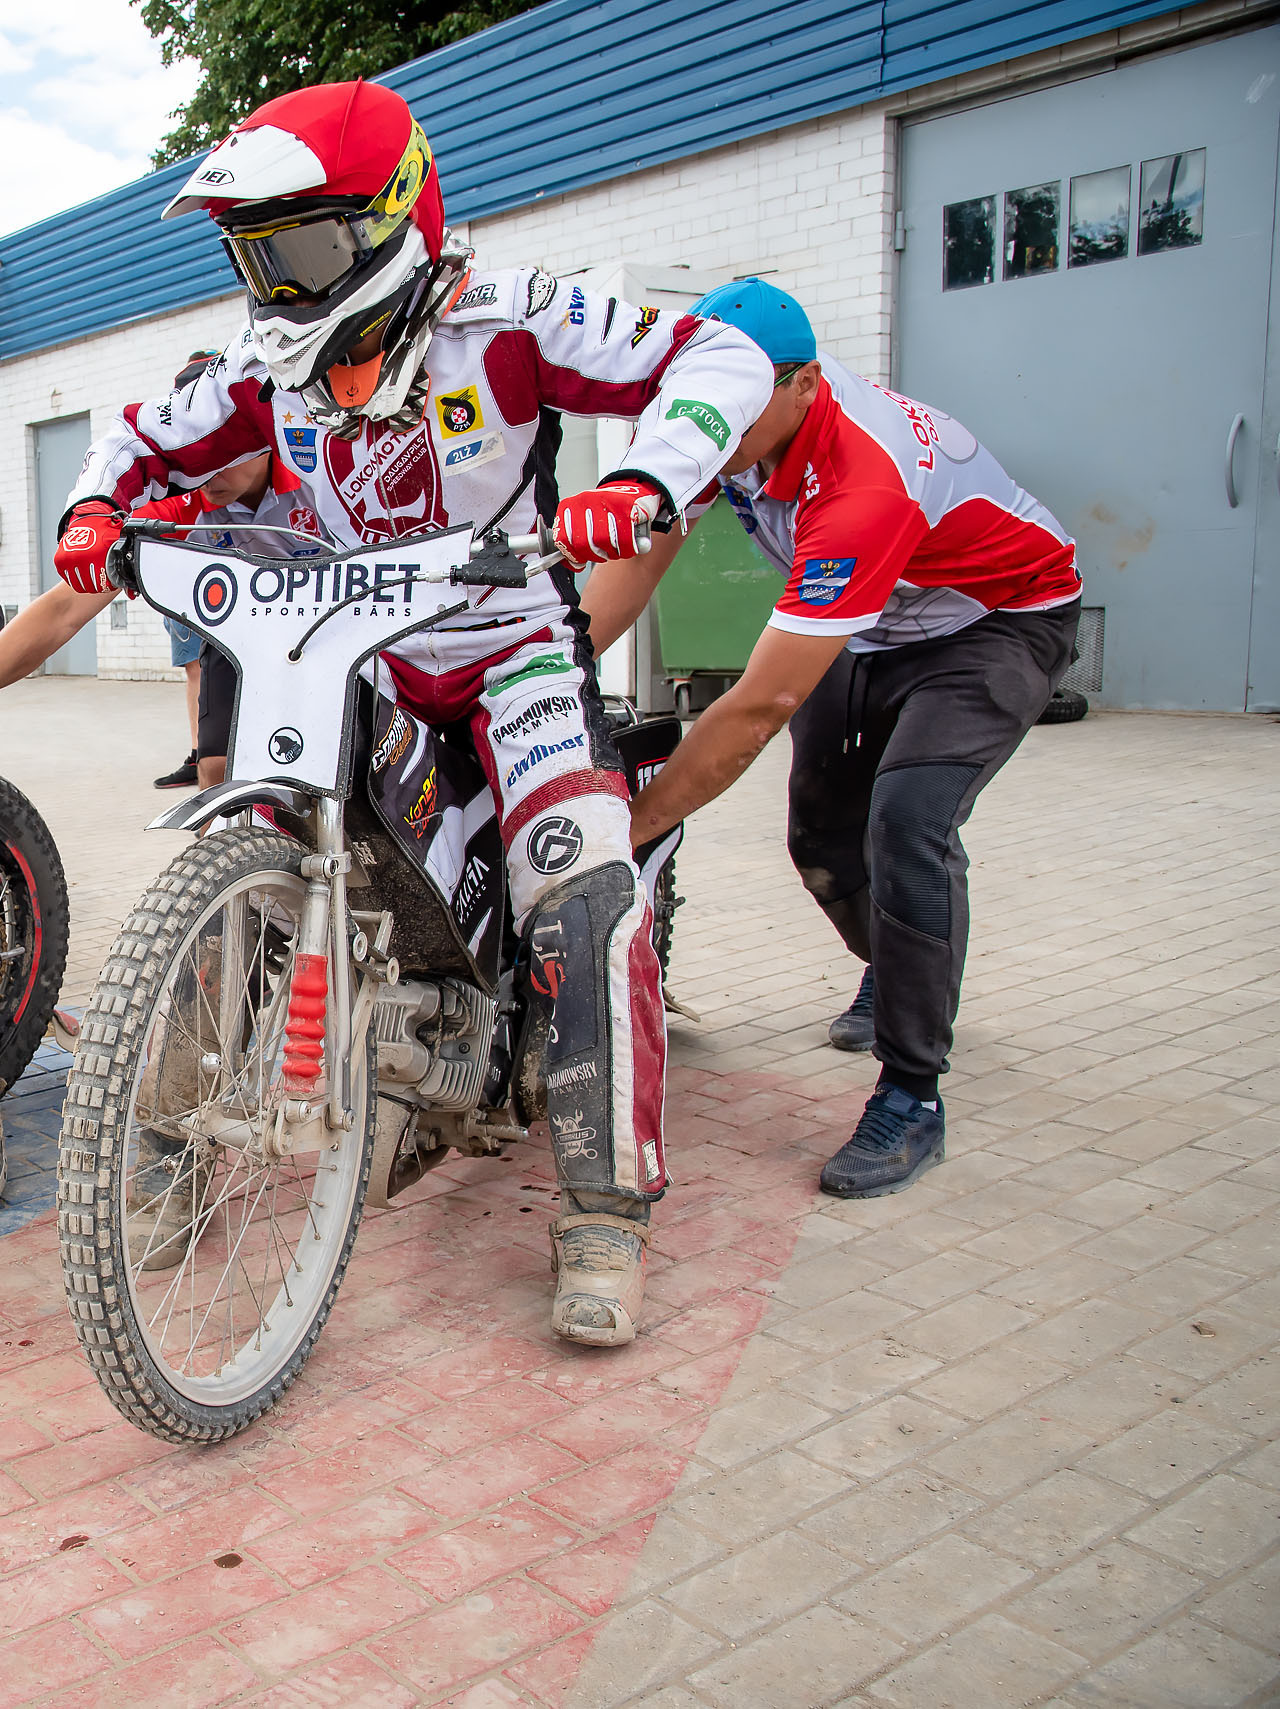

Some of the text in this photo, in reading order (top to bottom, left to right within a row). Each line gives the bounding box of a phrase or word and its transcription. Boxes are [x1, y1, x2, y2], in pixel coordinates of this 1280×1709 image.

[452, 420, 471, 432] PZM
[383, 435, 426, 484] DAUGAVPILS
[452, 444, 473, 463] 2LŽ
[386, 446, 428, 492] SPEEDWAY CLUB
[250, 562, 421, 604] OPTIBET
[354, 605, 412, 617] BĀRS
[512, 711, 570, 740] FAMILY
[546, 1060, 598, 1090] ARANOWSKY
